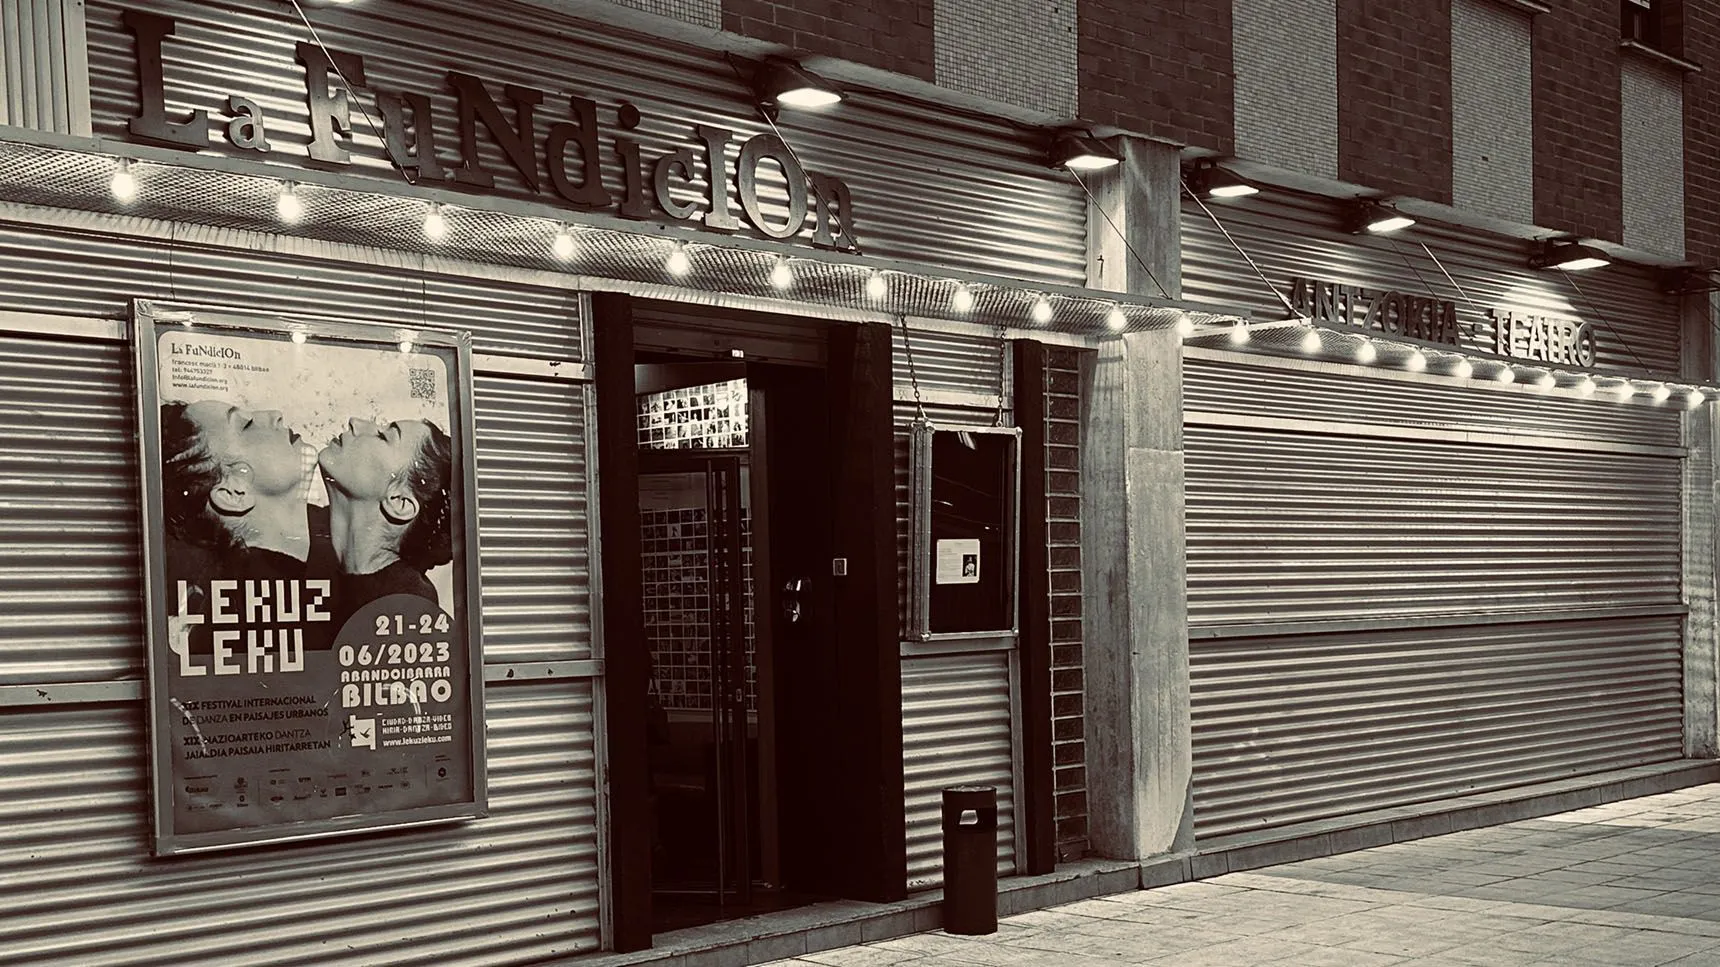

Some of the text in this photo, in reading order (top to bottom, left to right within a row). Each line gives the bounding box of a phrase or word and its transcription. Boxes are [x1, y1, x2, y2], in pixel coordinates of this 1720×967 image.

[123, 9, 271, 153] La
[1290, 277, 1597, 368] ANTZOKIA TEATRO
[171, 343, 183, 354] La
[177, 579, 331, 625] LEKUZ
[376, 613, 450, 636] 21-24
[179, 628, 305, 677] LEKU
[339, 642, 450, 667] 06/2023
[341, 666, 450, 682] ABANDOIBARRA
[201, 698, 243, 710] FESTIVAL
[244, 696, 316, 708] INTERNACIONAL
[342, 679, 452, 708] BILBAO
[196, 714, 228, 724] DANZA
[229, 713, 242, 722] EN
[243, 710, 284, 722] PAISAJES
[286, 708, 328, 720] URBANOS
[204, 731, 274, 745] NAZIOARTEKO
[275, 729, 312, 740] DANTZA
[383, 735, 452, 747] www.lekuzleku.com
[228, 745, 264, 756] PAISAIA
[266, 740, 331, 754] HIRITARRETAN
